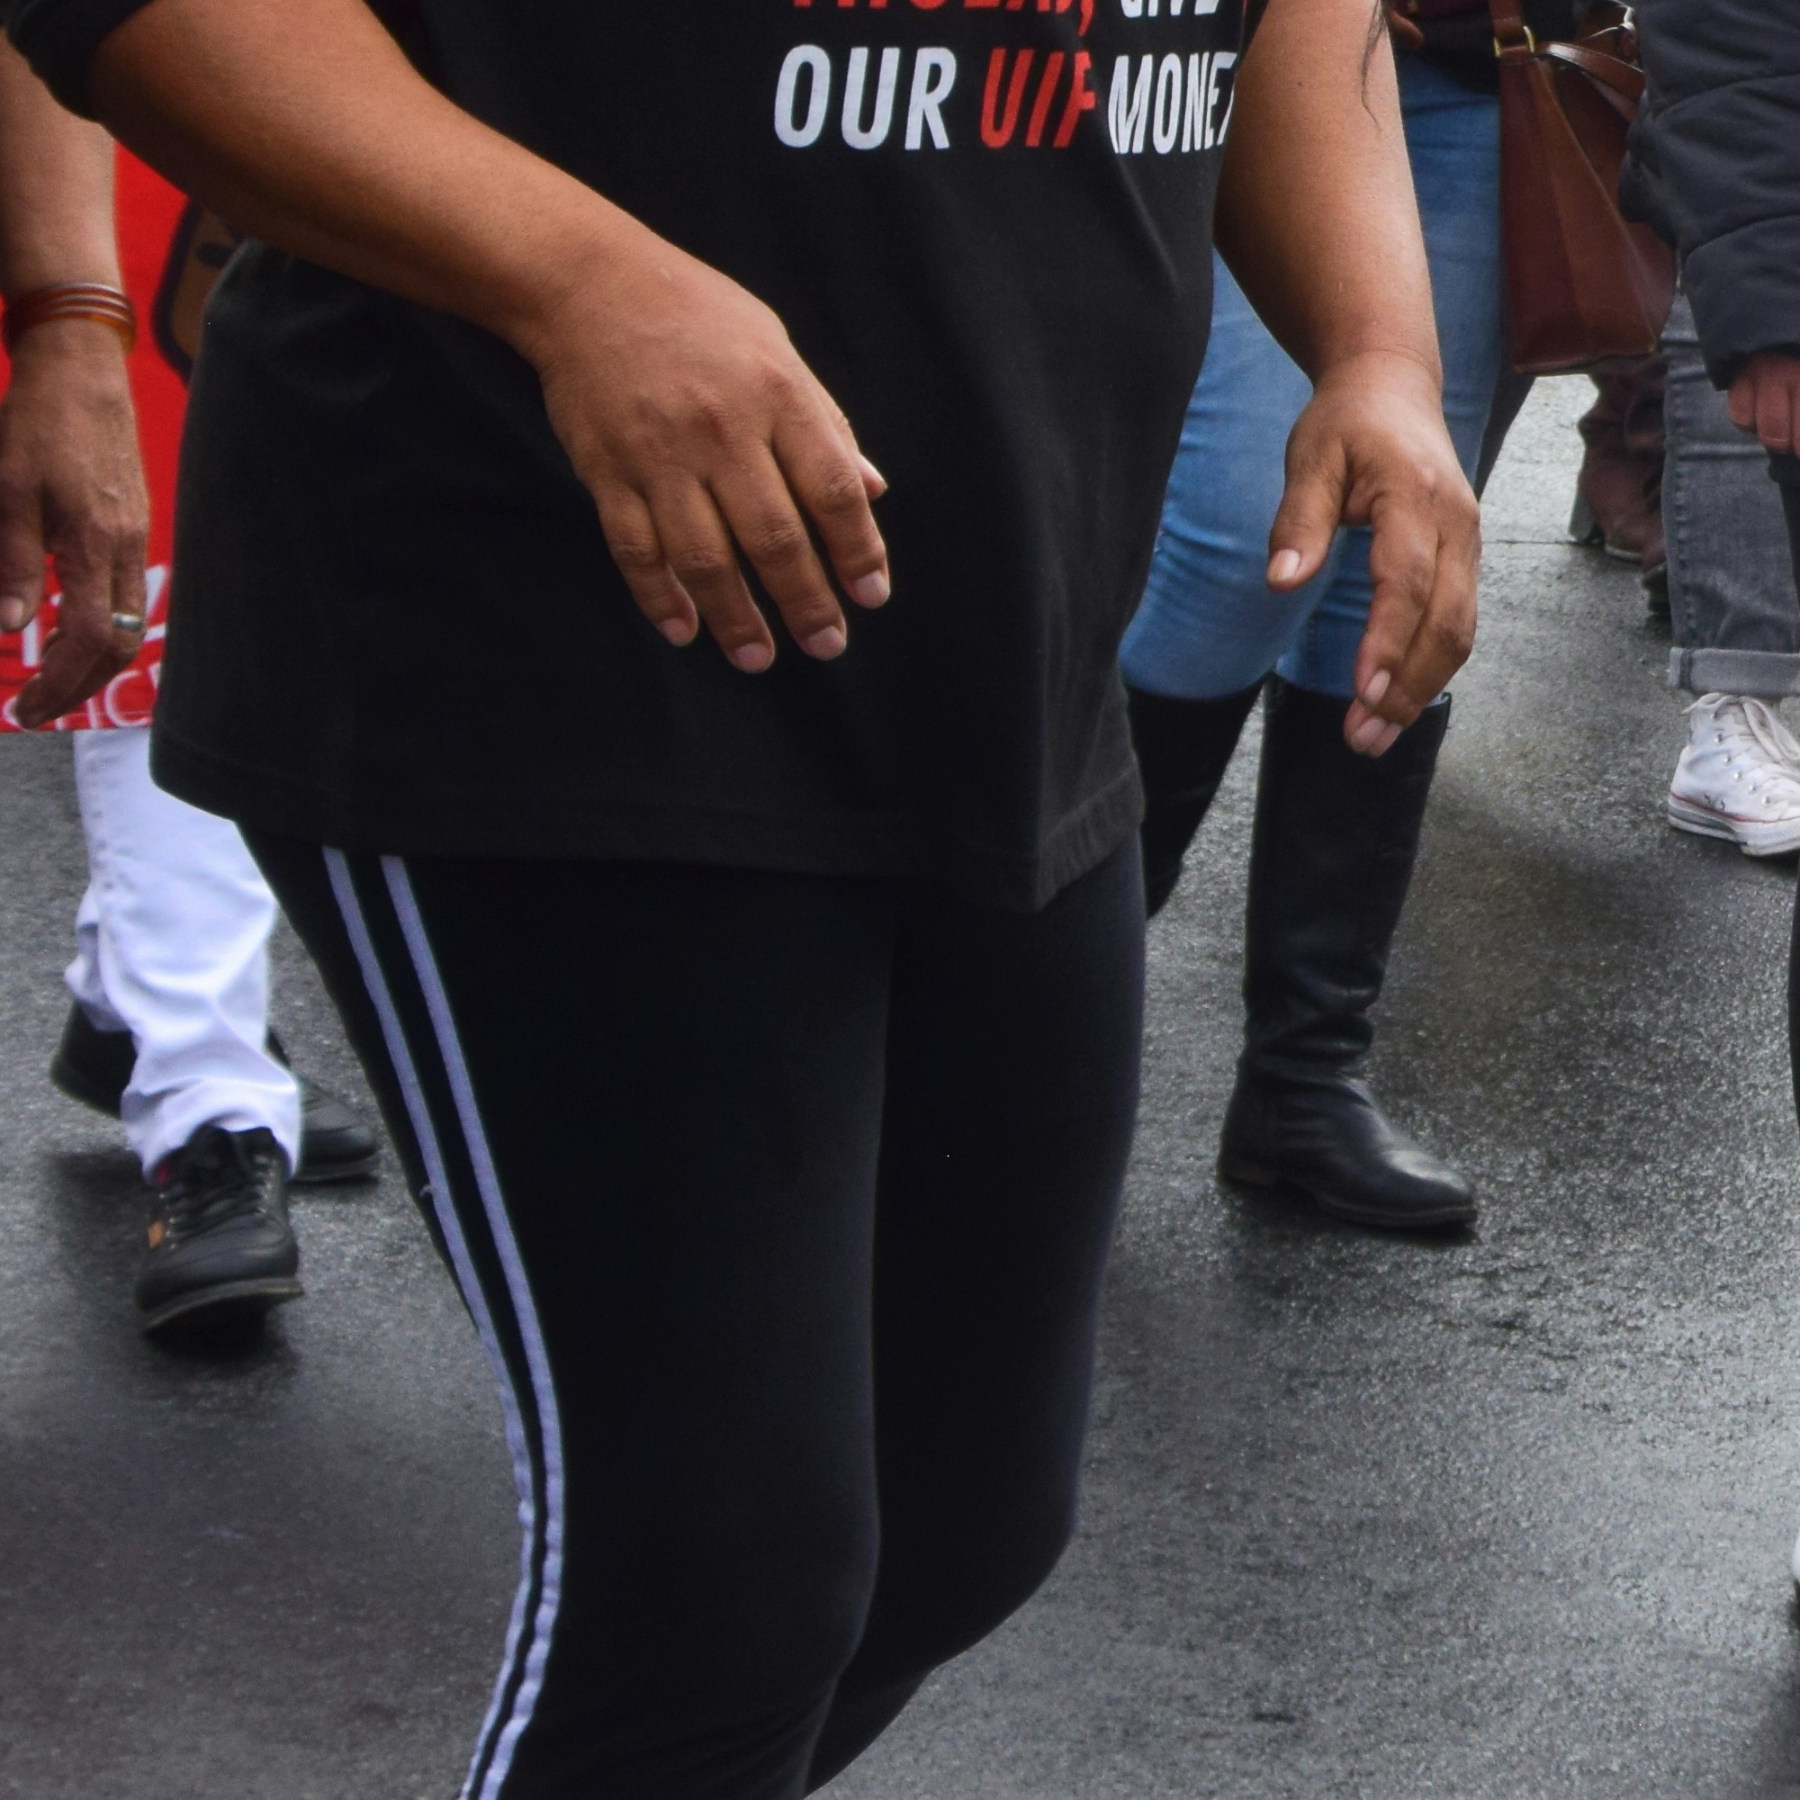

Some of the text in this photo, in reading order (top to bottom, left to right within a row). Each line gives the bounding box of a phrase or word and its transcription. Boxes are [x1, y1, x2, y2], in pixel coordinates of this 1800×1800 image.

[774, 44, 1239, 156] OUR UIF MONE
